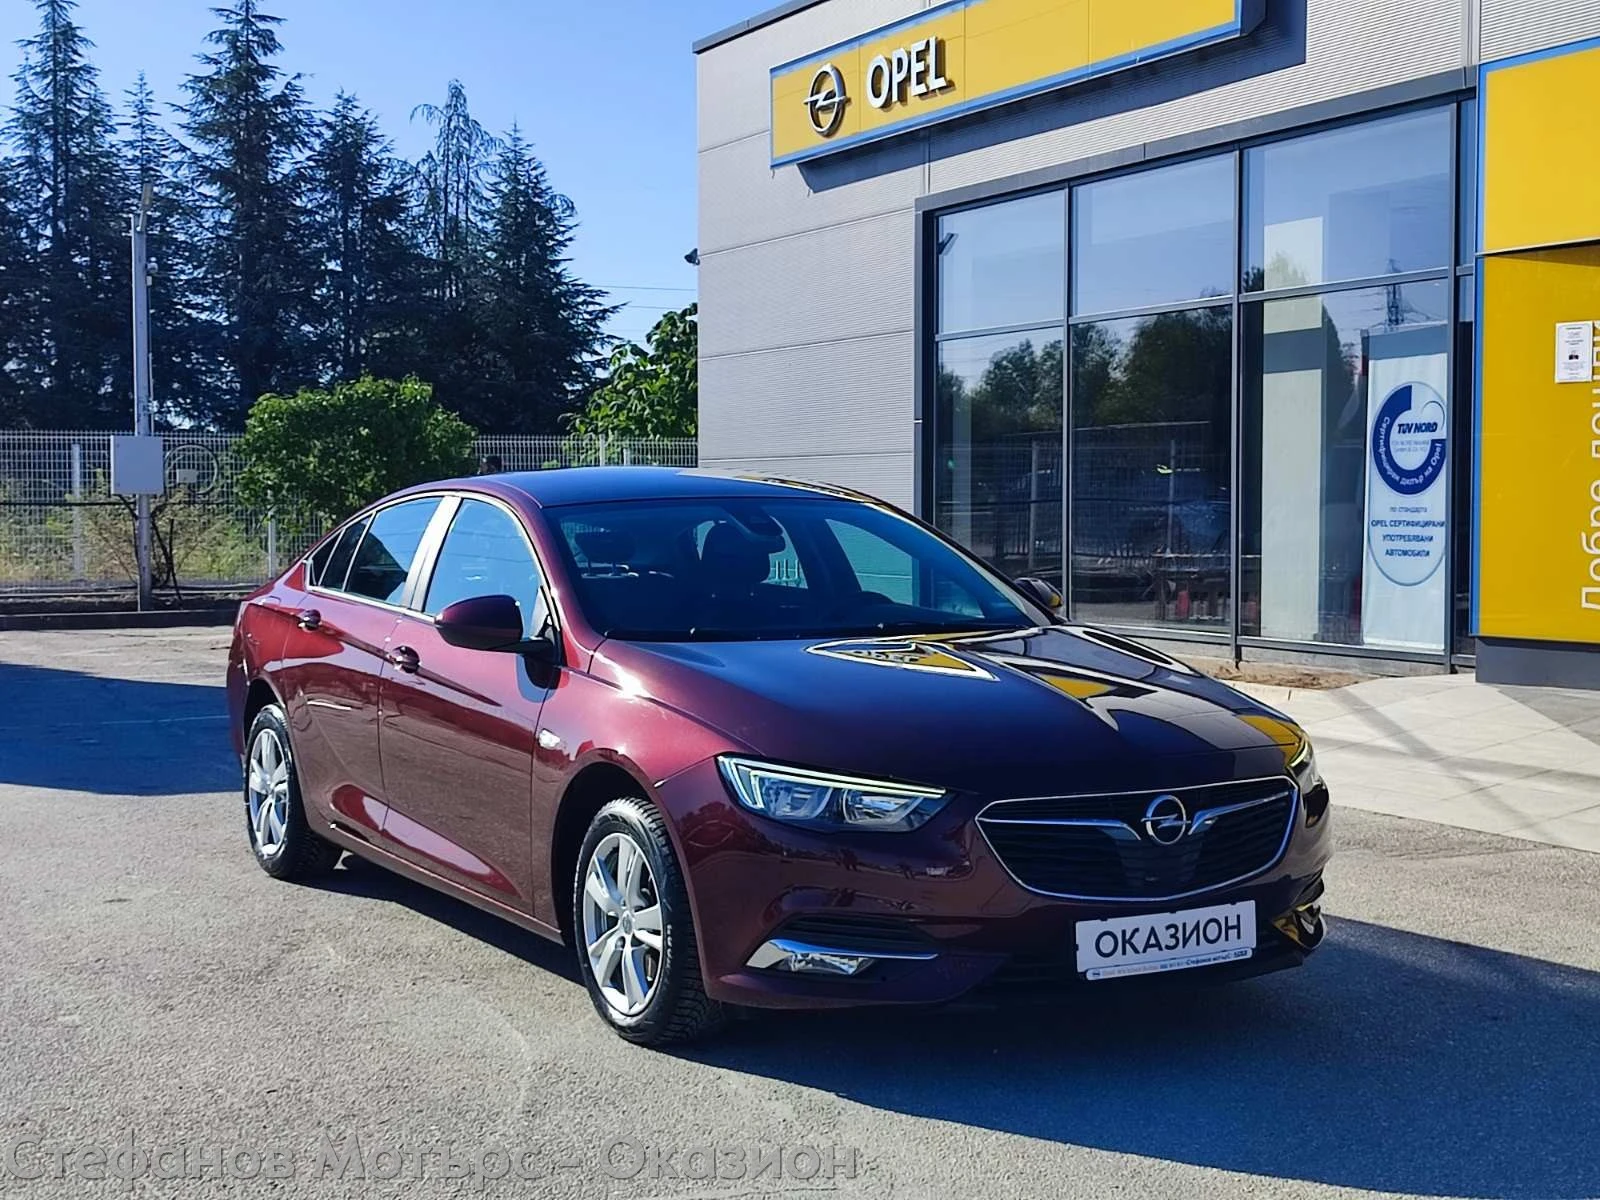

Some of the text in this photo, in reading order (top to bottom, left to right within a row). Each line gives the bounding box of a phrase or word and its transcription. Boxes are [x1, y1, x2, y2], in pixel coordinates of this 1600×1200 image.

[865, 36, 947, 109] OPEL
[1413, 421, 1438, 433] NORD
[1430, 443, 1443, 466] Opel
[1371, 519, 1388, 528] OPEL
[1385, 548, 1430, 557] АВТОМОБИЛИ
[1094, 913, 1242, 959] ОКАЗИОН
